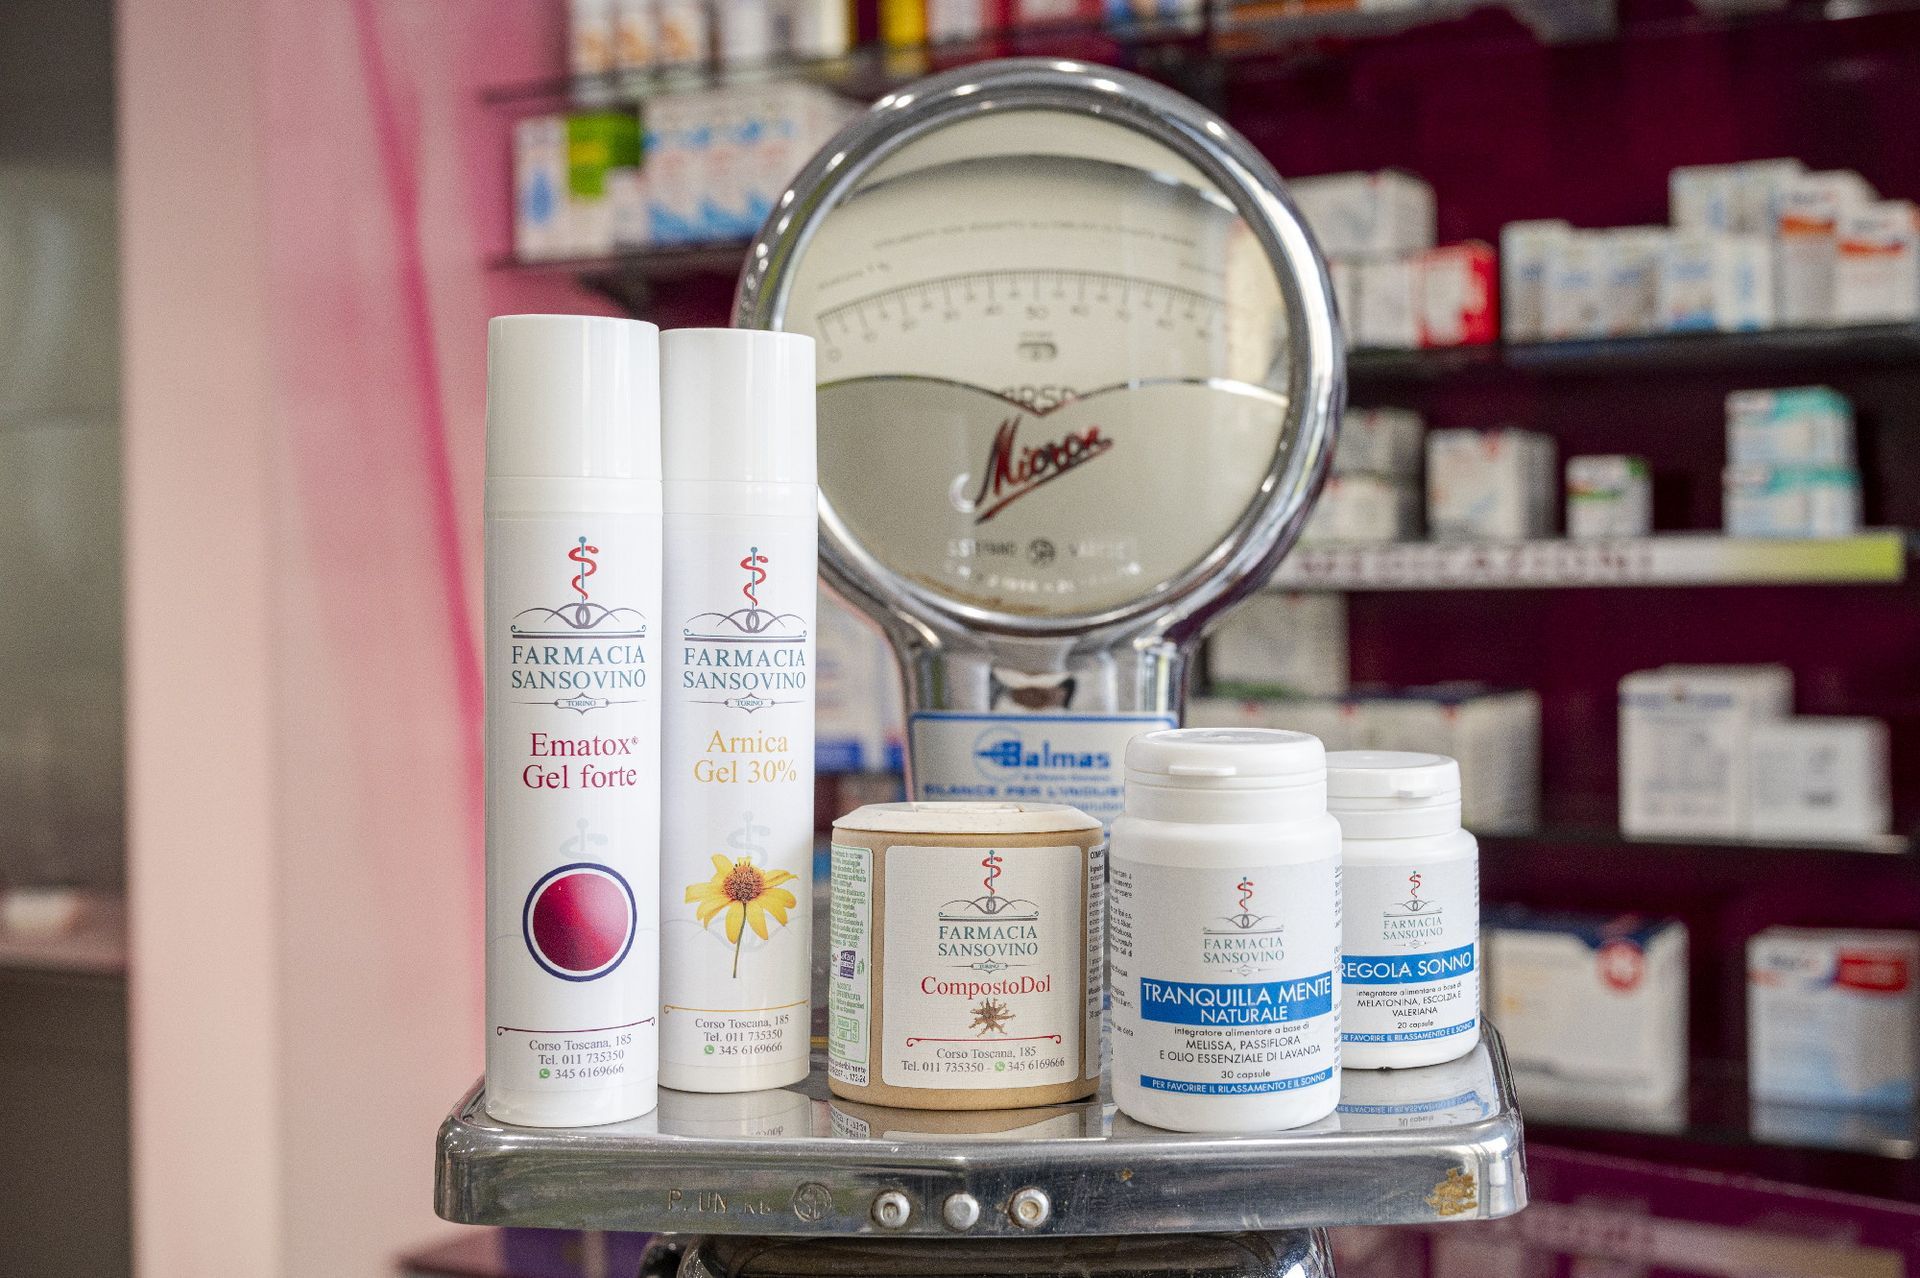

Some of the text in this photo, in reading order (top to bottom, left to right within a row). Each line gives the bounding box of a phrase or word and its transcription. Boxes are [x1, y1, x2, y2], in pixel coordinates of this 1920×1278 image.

[511, 645, 646, 665] FARMACIA
[684, 648, 806, 667] FARMACIA
[511, 669, 646, 689] SANSOVINO
[683, 671, 806, 690] SANSOVINO
[706, 729, 788, 753] Arnica
[523, 764, 637, 789] Gel forte
[694, 759, 797, 783] Gel 30%
[1384, 917, 1442, 929] FARMACIA
[938, 925, 1038, 940] FARMACIA
[1383, 928, 1443, 940] SANSOVINO
[938, 942, 1038, 957] SANSOVINO
[1204, 937, 1283, 949] FARMACIA
[1203, 950, 1285, 964] SANSOVINO
[1340, 952, 1472, 979] REGOLA SONNO
[921, 974, 1051, 1000] CompostoDol
[1143, 982, 1272, 1007] TRANQUILLA
[1278, 976, 1331, 1003] MENTE
[1357, 998, 1420, 1007] MELATONINA,
[1201, 1005, 1288, 1023] NATURALE
[1392, 1007, 1438, 1017] VALERIANA
[695, 1014, 789, 1029] Corso Toscana, 185
[1174, 1027, 1222, 1038] integratore
[1283, 1024, 1301, 1034] base
[1303, 1021, 1310, 1030] di
[529, 1040, 561, 1051] Corso
[615, 1033, 632, 1046] 185
[704, 1029, 783, 1042] Tel. 011 735350
[1186, 1035, 1300, 1052] MELISSA, PASSIFLORA
[719, 1042, 783, 1055] 345 6169666
[936, 1046, 1037, 1059] Corso Toscana, 185
[1159, 1044, 1321, 1064] E OLIO ESSENZIALE DI LAVANDA
[538, 1050, 624, 1065] Tel. 011 735350
[901, 1060, 920, 1072] Tel.
[922, 1062, 940, 1072] 011
[945, 1062, 984, 1073] 735350
[1007, 1061, 1025, 1072] 345
[1028, 1057, 1065, 1070] 6169666
[555, 1064, 624, 1079] 345 6169666
[1221, 1069, 1270, 1080] 30 capsule
[1152, 1079, 1165, 1088] PER
[1167, 1082, 1207, 1093] FAVORIRE
[1209, 1085, 1216, 1093] IL
[1218, 1080, 1285, 1093] RILASSAMENTO
[1300, 1072, 1326, 1087] SONNO
